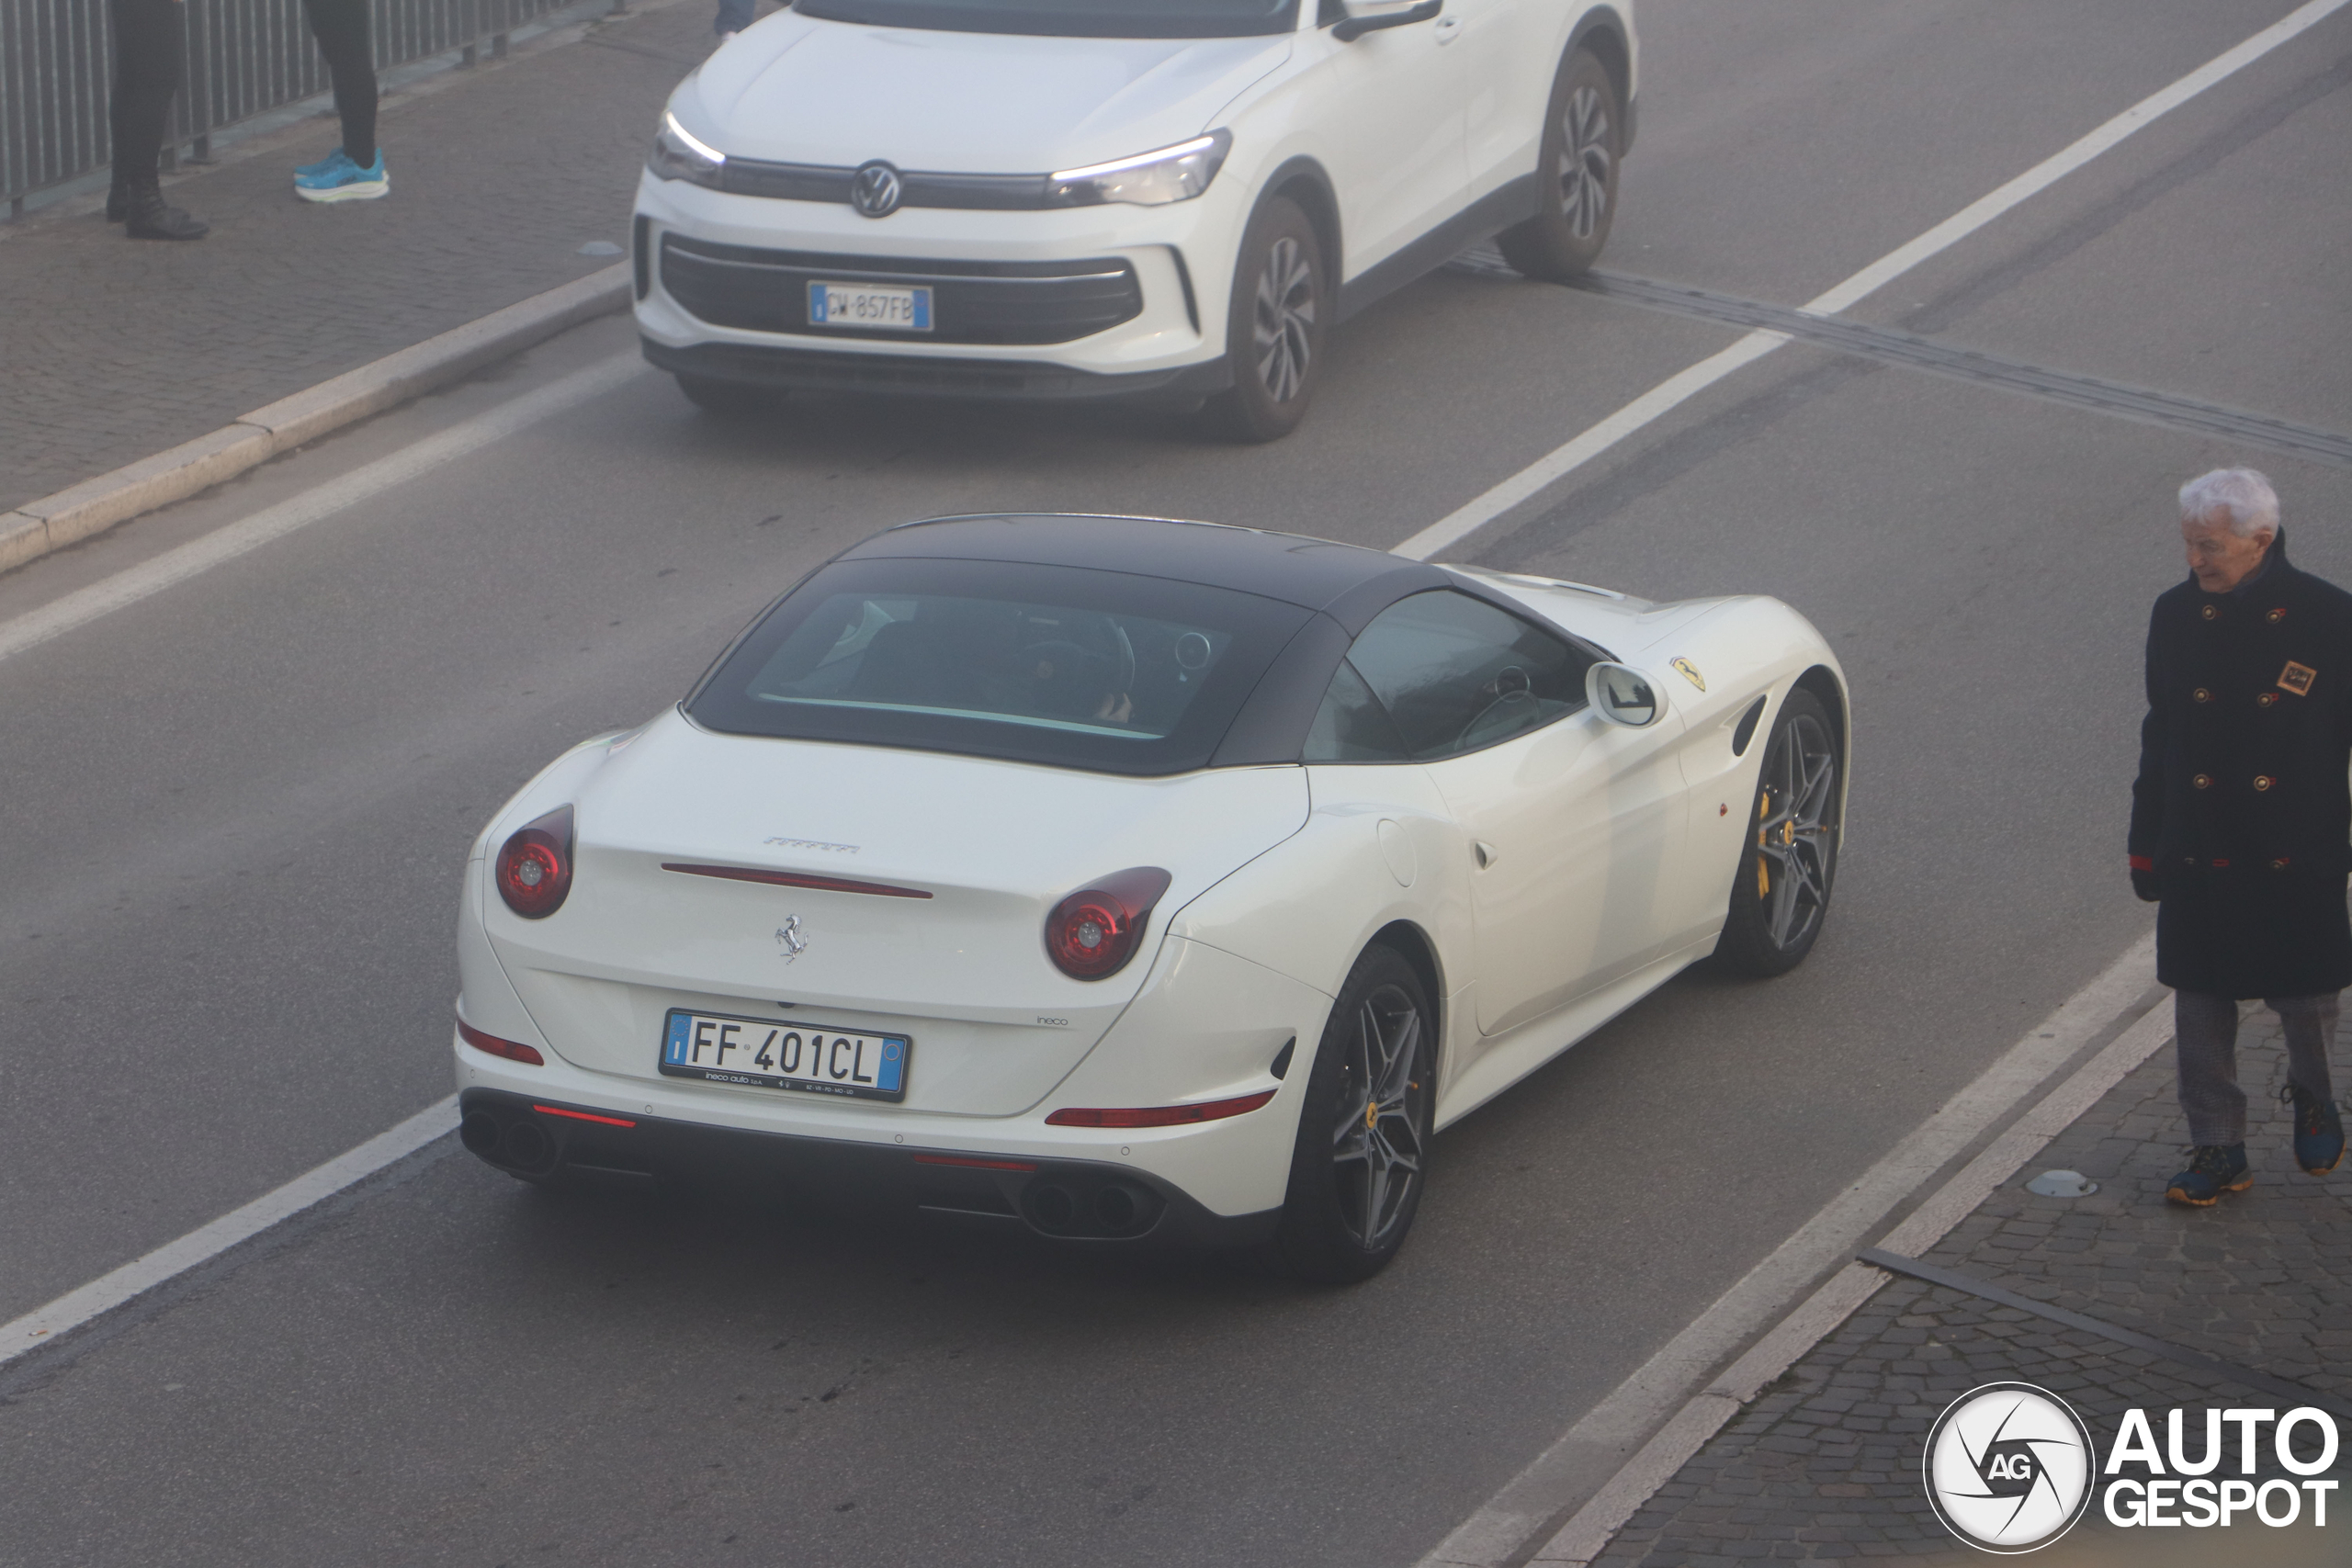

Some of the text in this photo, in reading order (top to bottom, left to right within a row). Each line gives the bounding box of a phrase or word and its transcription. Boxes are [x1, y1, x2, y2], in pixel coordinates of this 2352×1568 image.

[856, 294, 913, 320] 857FB
[1036, 1015, 1069, 1026] ineco
[692, 1021, 741, 1066] FF
[754, 1030, 873, 1082] 401CL
[705, 1071, 729, 1082] ineco
[730, 1075, 750, 1084] auto
